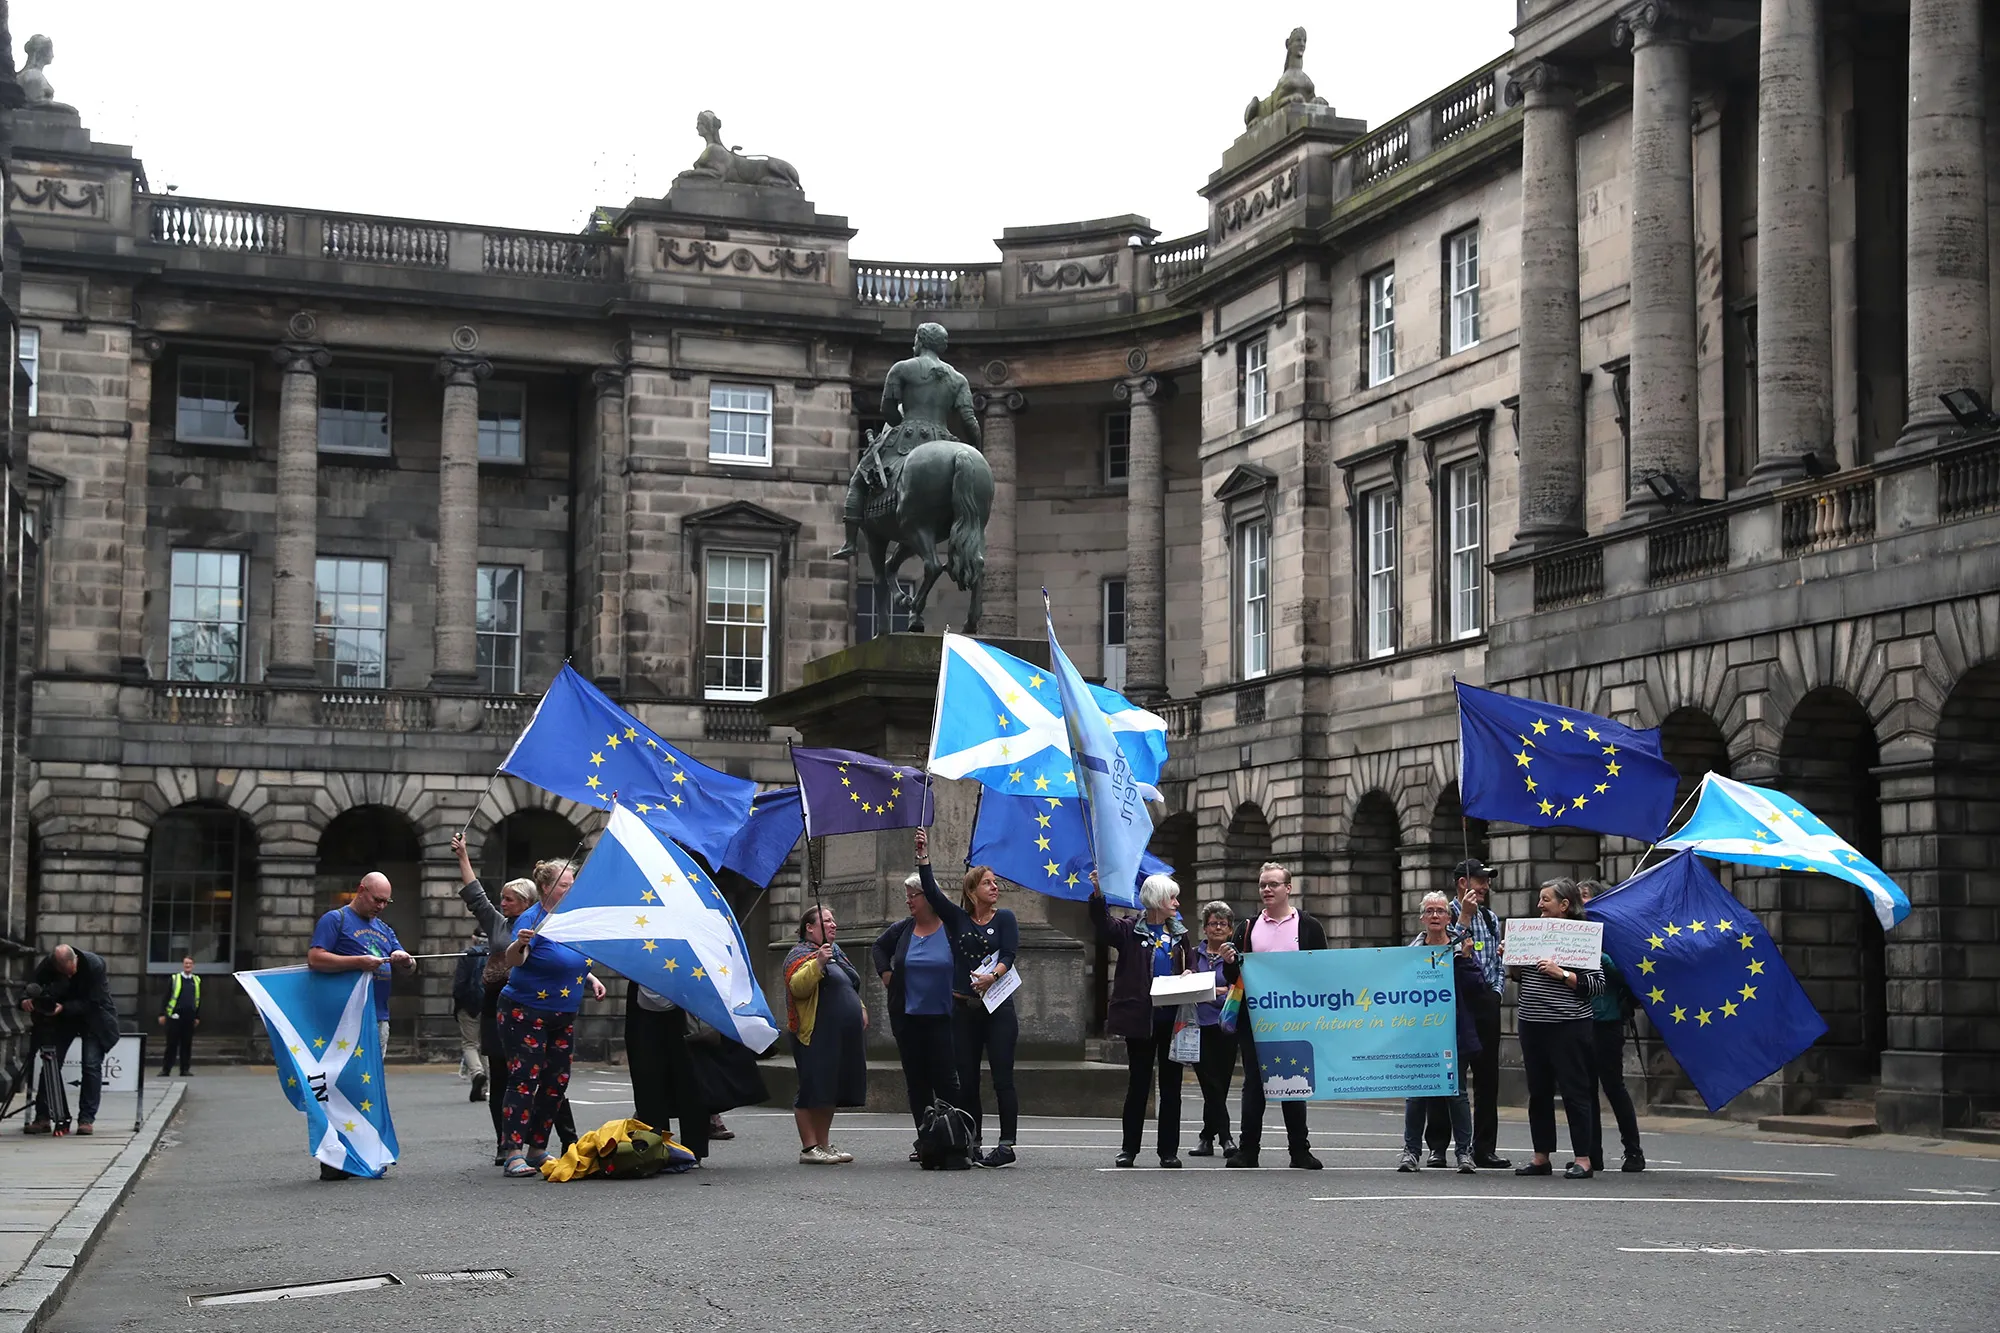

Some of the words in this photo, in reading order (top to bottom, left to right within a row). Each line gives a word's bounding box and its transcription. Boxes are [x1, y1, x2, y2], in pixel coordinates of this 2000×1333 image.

[1519, 921, 1543, 932] demand
[1546, 921, 1602, 936] DEMOCRACY
[1247, 988, 1452, 1012] edinburgh4europe
[1254, 1017, 1279, 1033] for
[1283, 1020, 1312, 1032] our
[1314, 1015, 1365, 1032] future
[1369, 1014, 1385, 1029] in
[1391, 1013, 1417, 1028] the
[1422, 1012, 1448, 1027] EU
[1351, 1051, 1440, 1061] www.euromovescotland.org.uk
[1385, 1072, 1440, 1081] @Edinburgh4Europe
